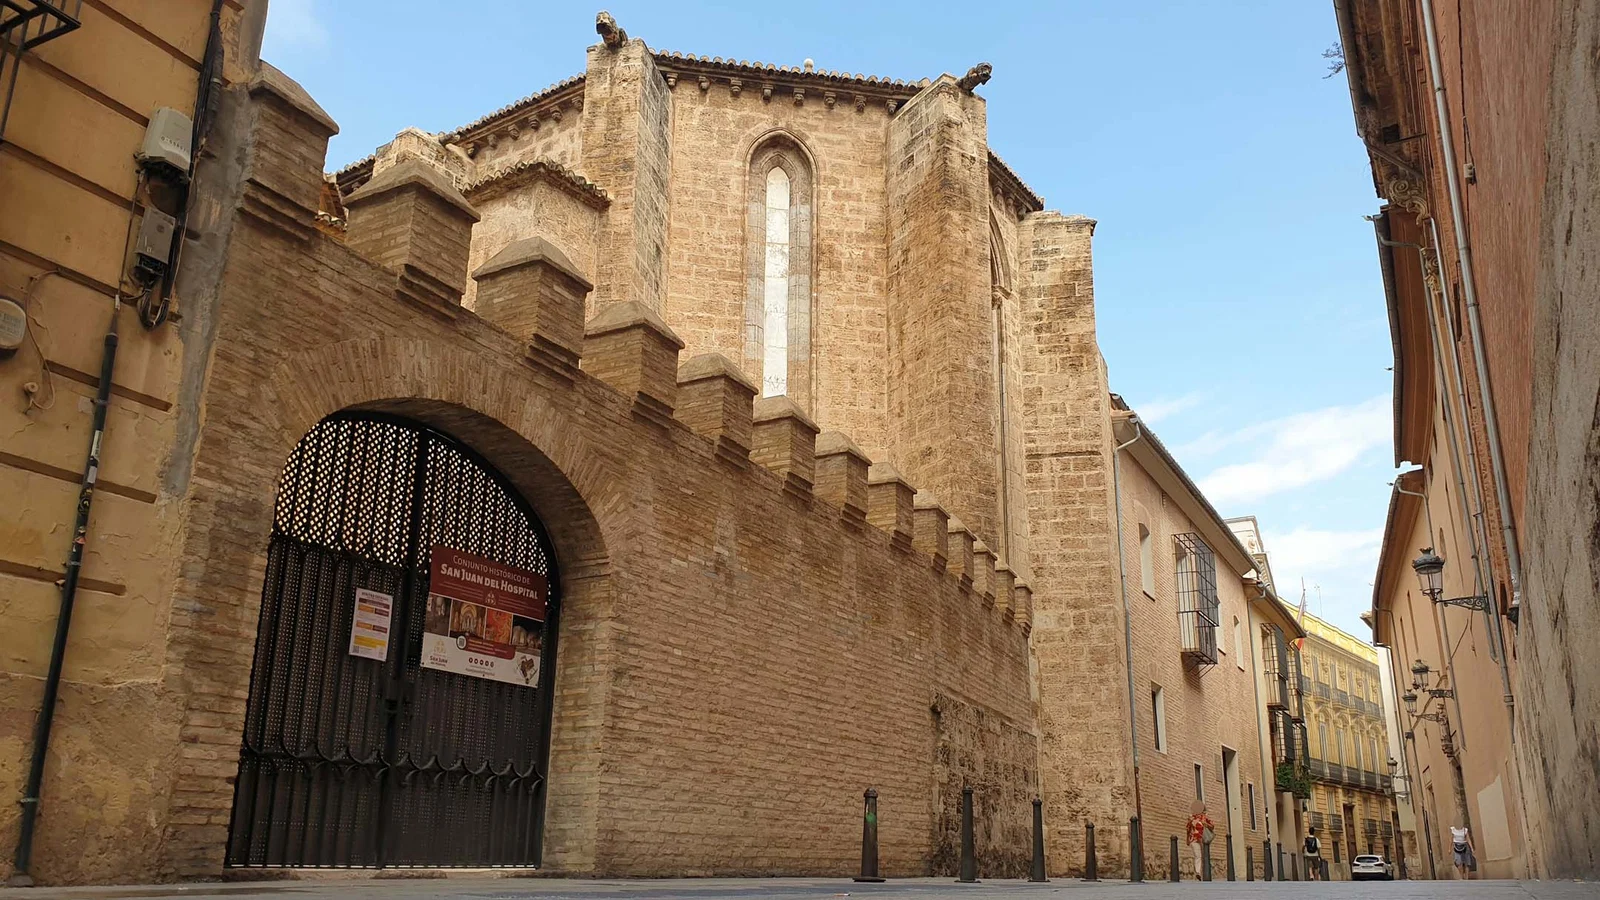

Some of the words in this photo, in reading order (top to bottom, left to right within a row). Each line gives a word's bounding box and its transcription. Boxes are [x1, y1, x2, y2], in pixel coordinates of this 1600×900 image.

[441, 563, 461, 578] SAN
[461, 568, 483, 585] JUAN
[484, 577, 500, 589] DEL
[500, 580, 538, 600] HOSPITAL
[453, 555, 488, 573] CONJUNTO
[489, 567, 521, 582] HISTÓRICO
[522, 577, 531, 585] DE
